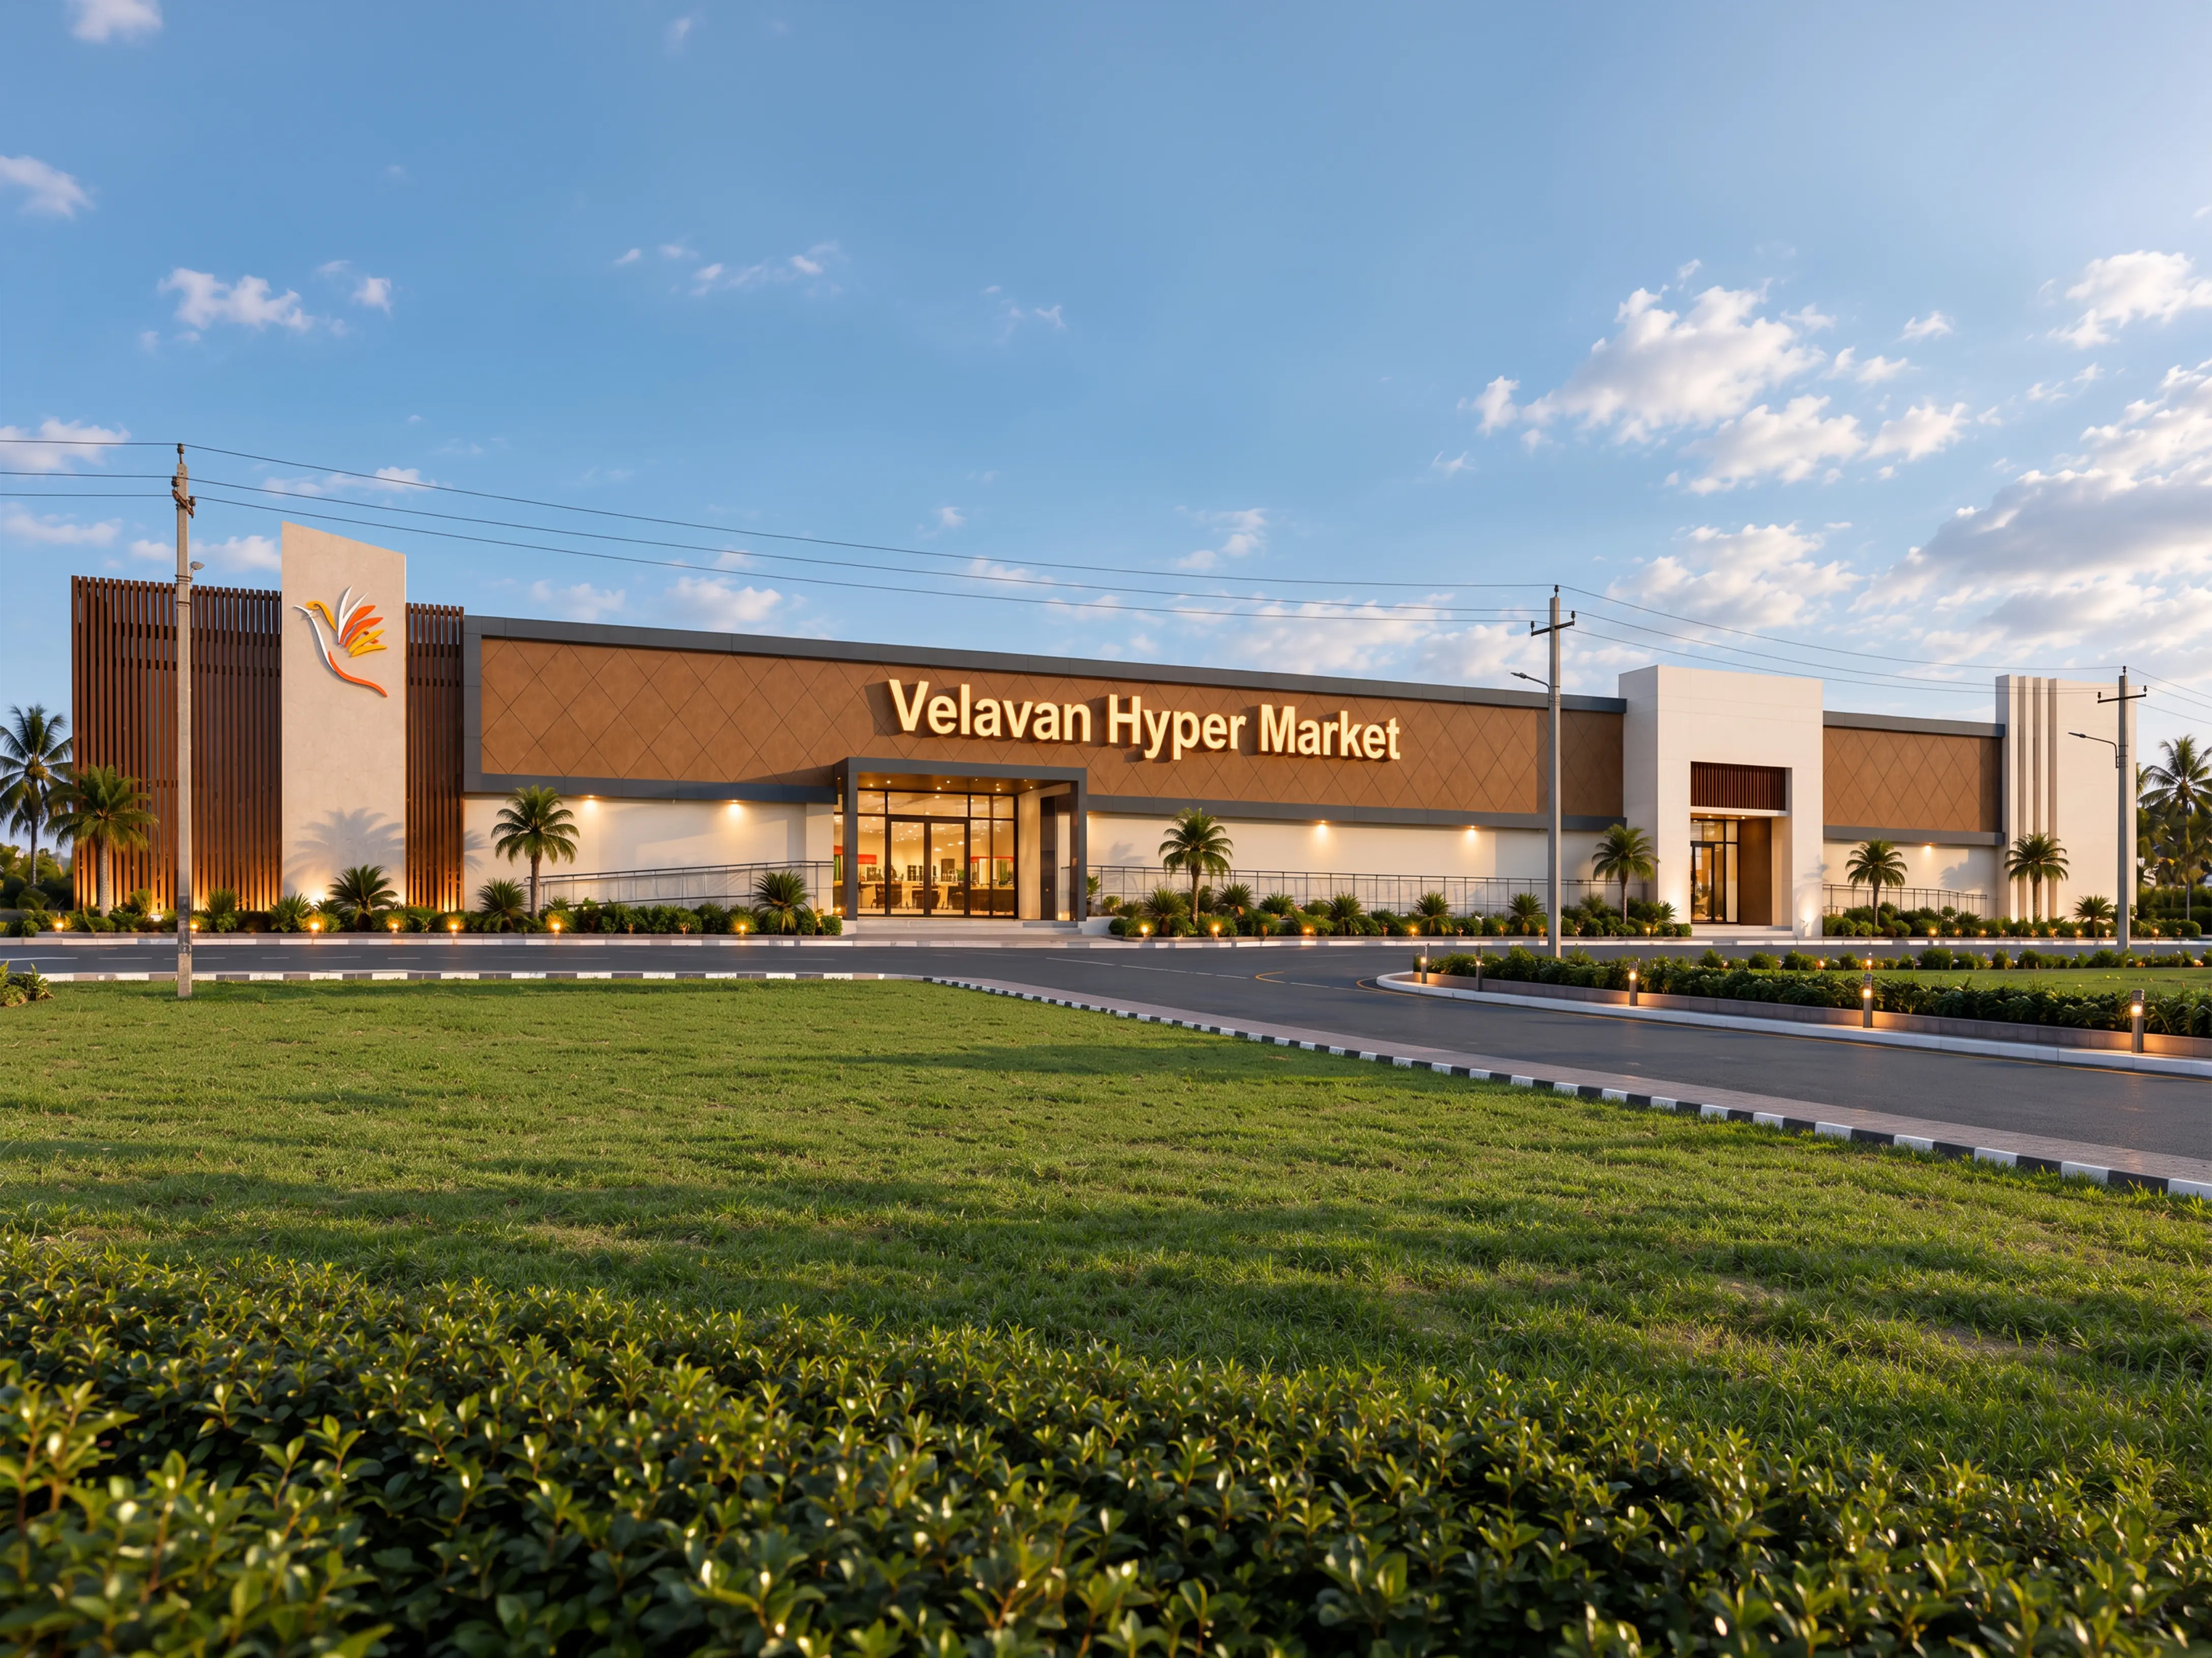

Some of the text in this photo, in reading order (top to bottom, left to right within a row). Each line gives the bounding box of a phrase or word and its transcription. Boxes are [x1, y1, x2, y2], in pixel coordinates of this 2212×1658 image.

[888, 679, 1401, 760] Velavan Hyper Market
